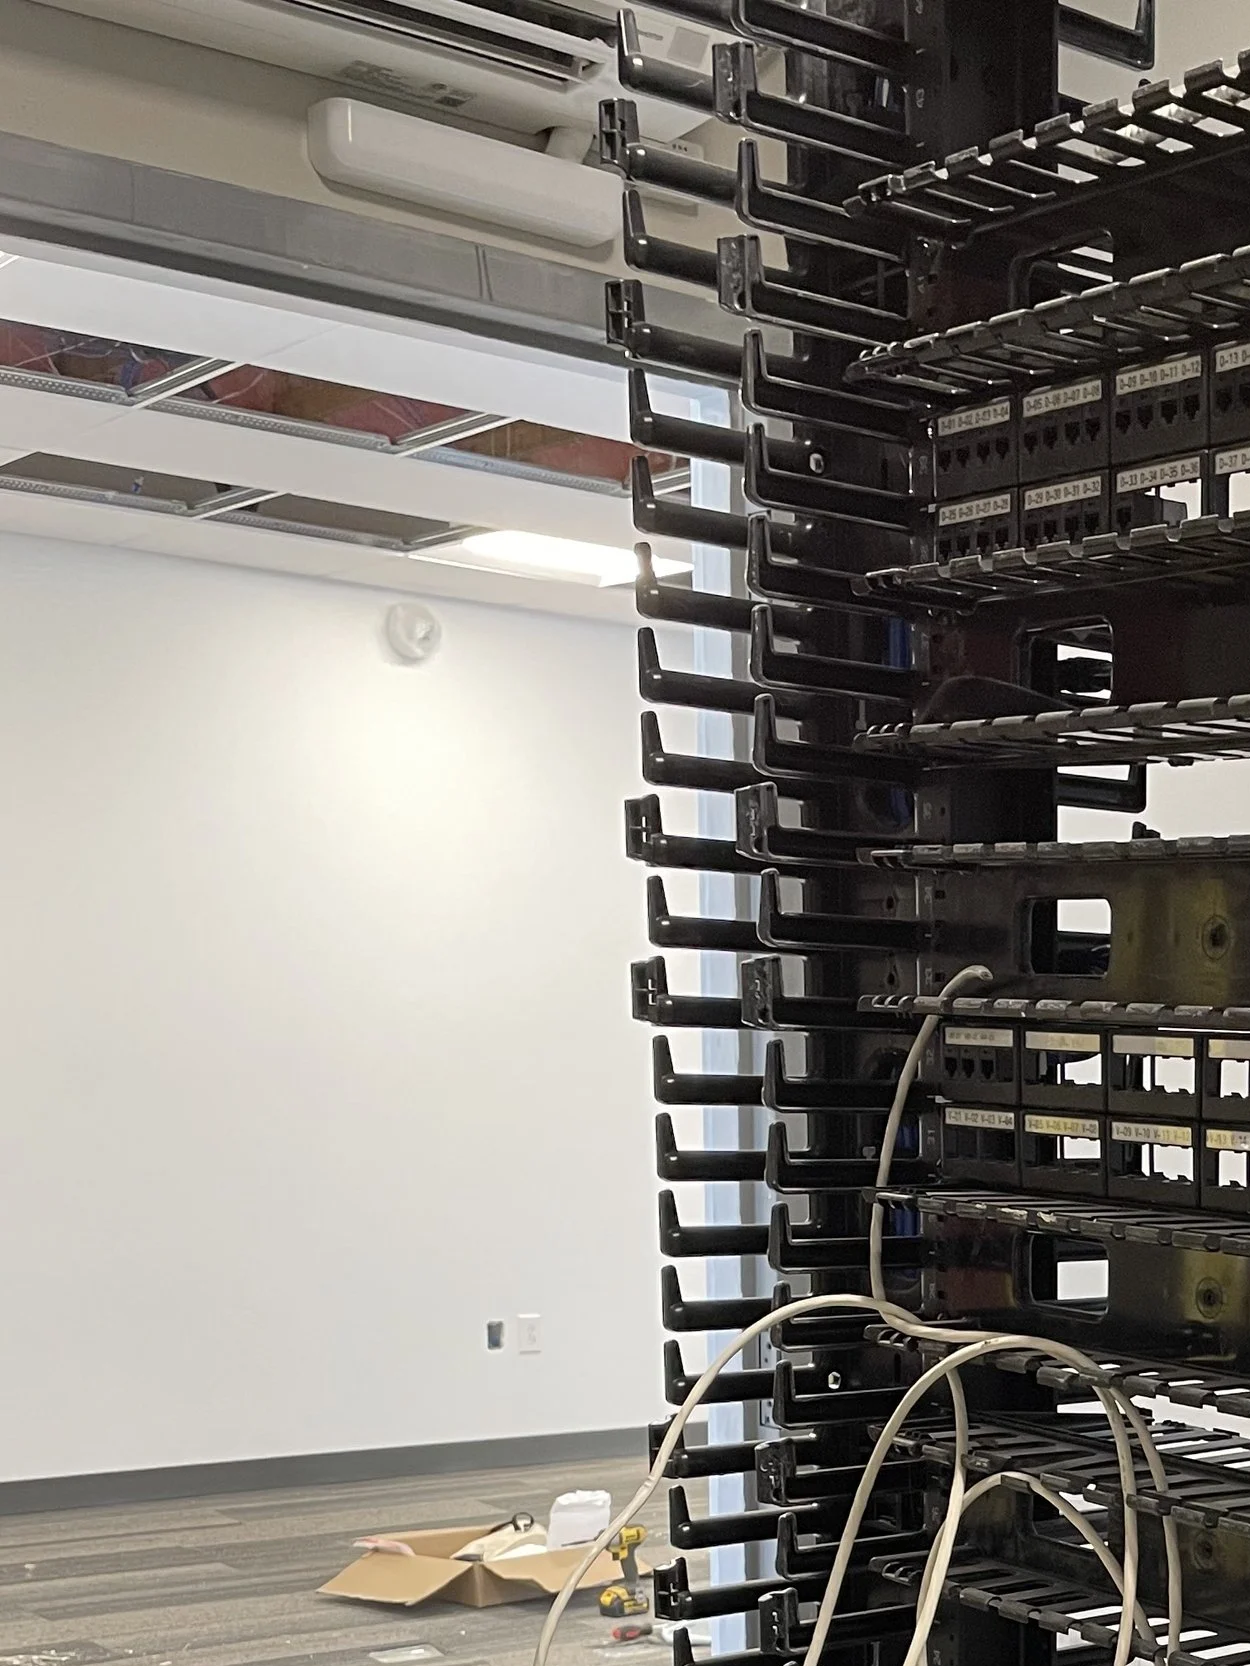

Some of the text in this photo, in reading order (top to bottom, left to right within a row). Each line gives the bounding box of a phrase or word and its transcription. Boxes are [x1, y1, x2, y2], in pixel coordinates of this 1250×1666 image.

[1219, 352, 1239, 368] D-13
[1160, 365, 1178, 380] D-11
[1219, 455, 1238, 470] D-37
